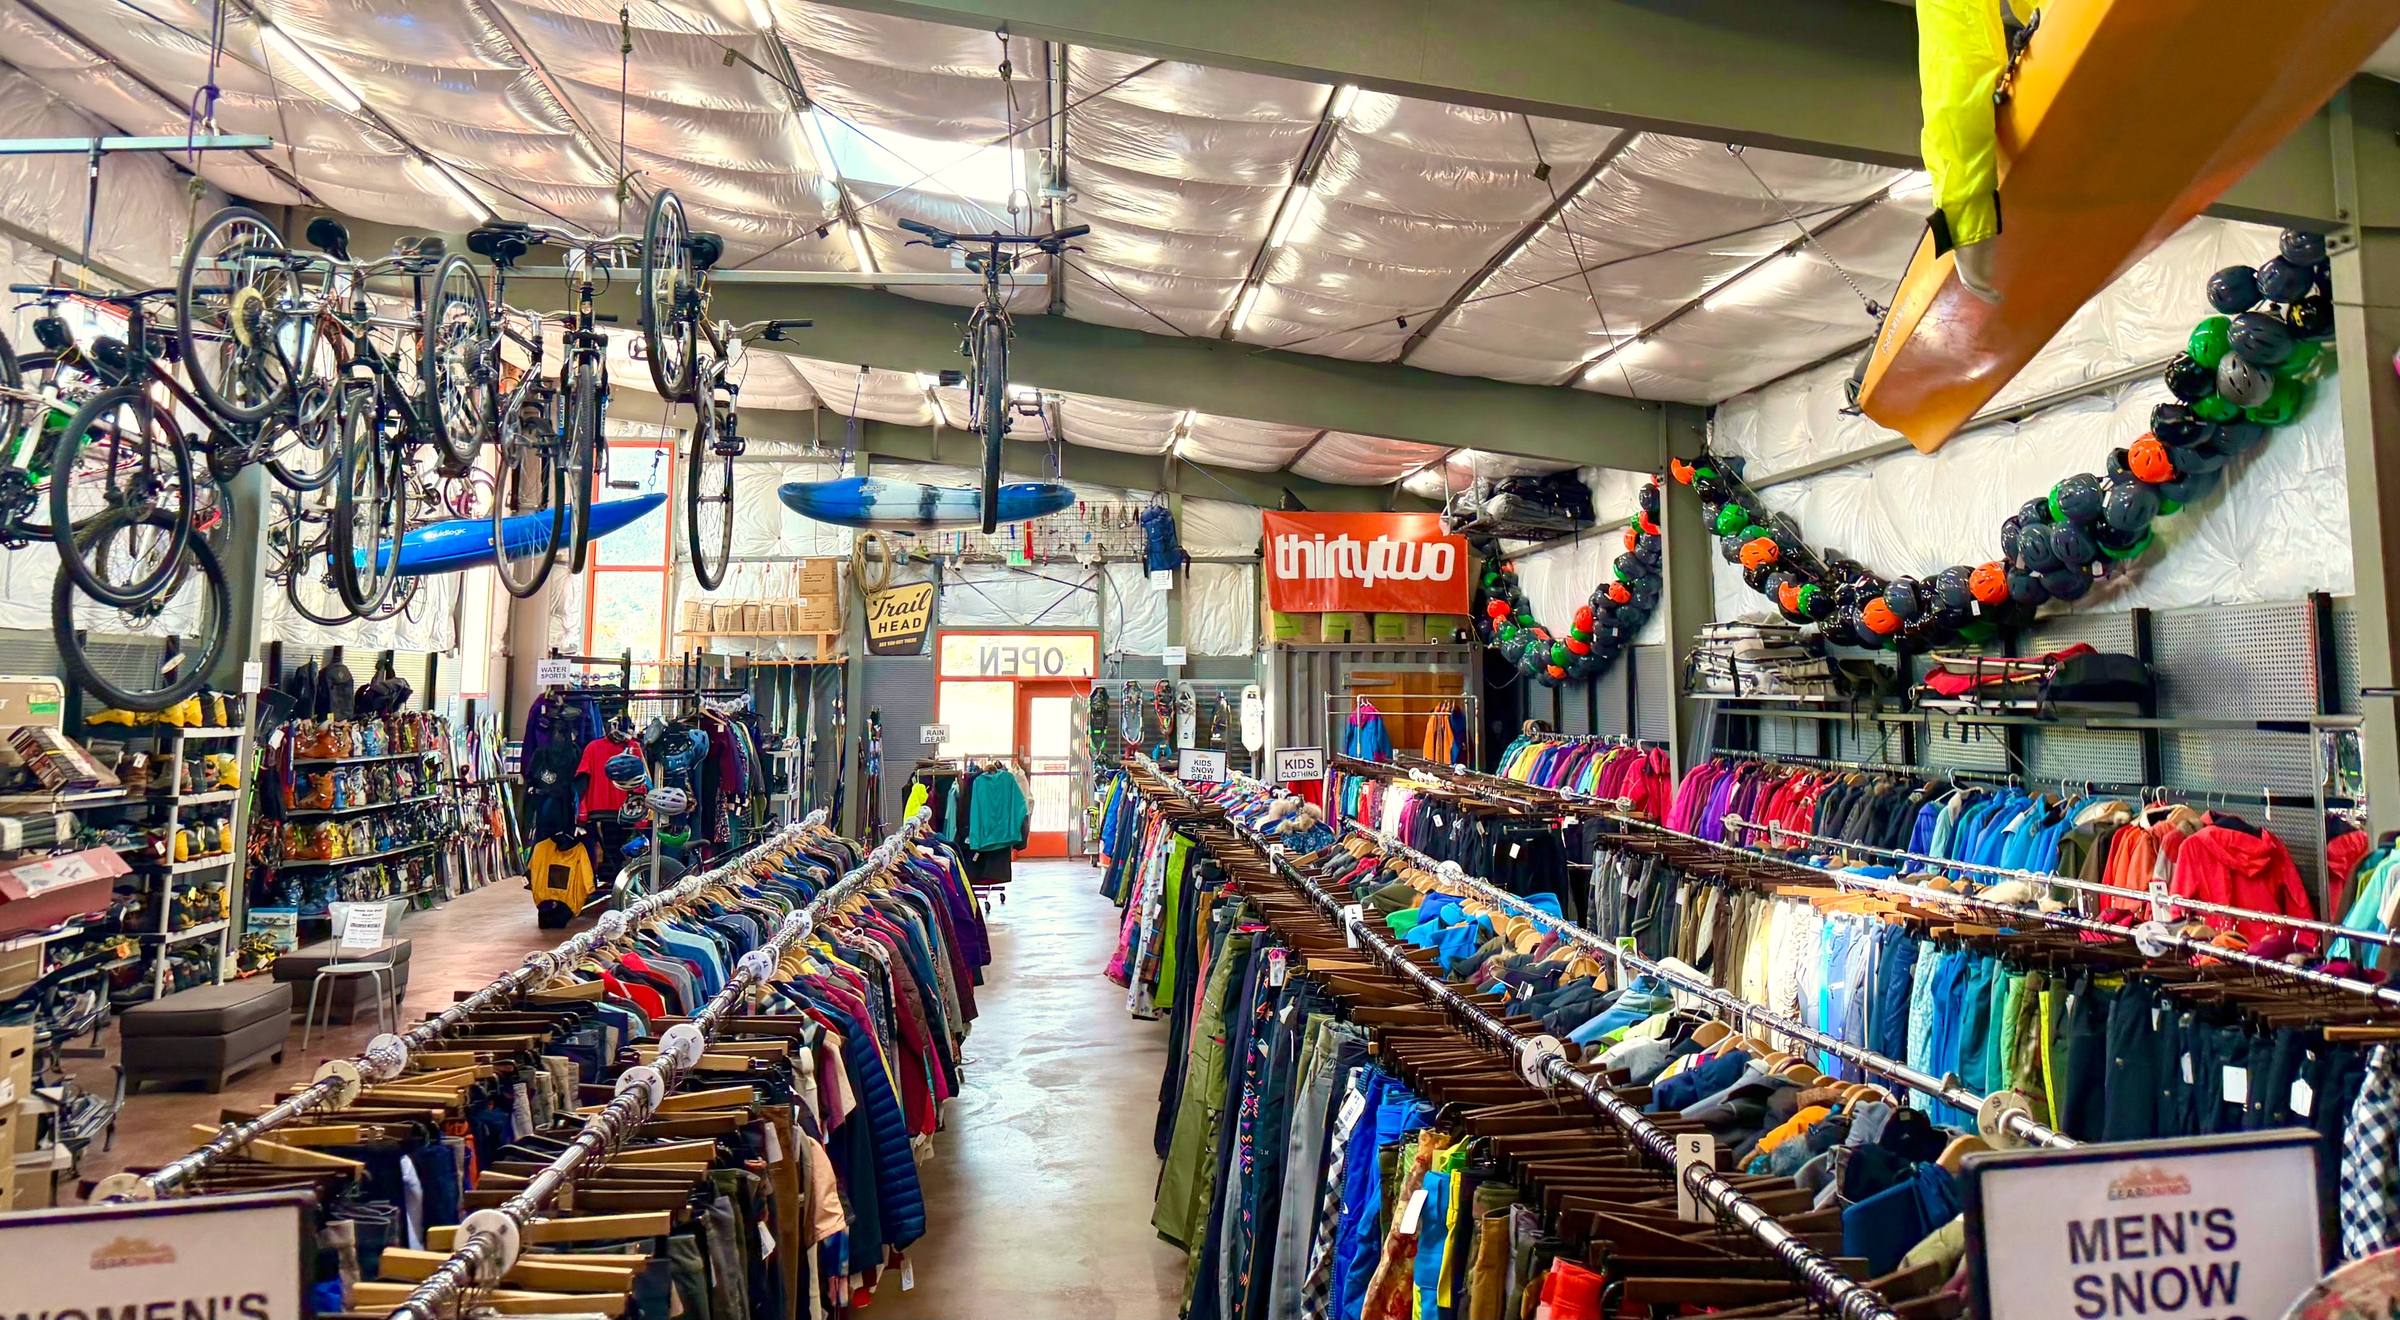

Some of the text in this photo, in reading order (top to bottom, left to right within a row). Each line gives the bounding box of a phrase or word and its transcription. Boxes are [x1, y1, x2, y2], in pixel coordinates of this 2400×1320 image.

[425, 528, 466, 540] quidlogic
[1275, 533, 1455, 588] thirtytwo
[870, 588, 931, 620] Trail
[878, 618, 921, 633] HEAD
[1193, 759, 1212, 767] KIDS
[1284, 758, 1315, 770] KIDS
[1190, 766, 1215, 774] SNOW
[1281, 770, 1319, 778] CLOTHING
[1535, 1040, 1543, 1050] M
[331, 1065, 338, 1073] L
[624, 1074, 634, 1084] M
[647, 1075, 657, 1086] M
[1691, 1141, 1700, 1153] S
[2068, 1207, 2237, 1265] MEN'S
[2073, 1260, 2241, 1320] SNOW
